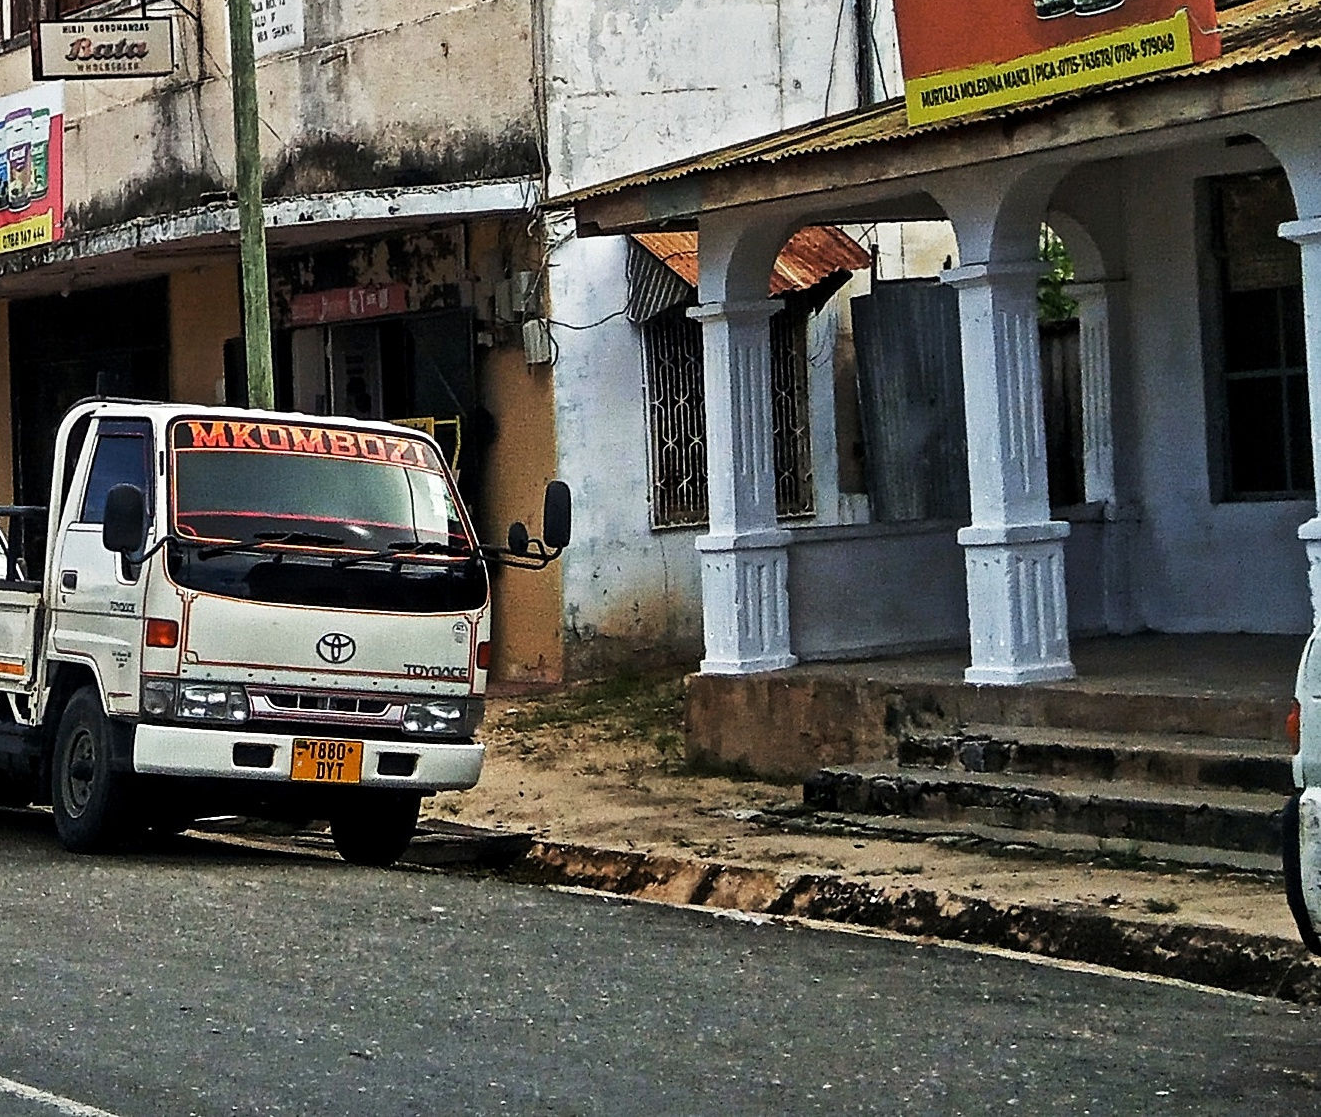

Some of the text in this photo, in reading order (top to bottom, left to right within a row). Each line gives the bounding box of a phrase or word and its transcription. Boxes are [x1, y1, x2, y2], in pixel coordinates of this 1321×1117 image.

[65, 37, 150, 61] Bata
[188, 421, 428, 468] MKOMBOZI
[404, 664, 468, 678] TOYOACE
[309, 741, 347, 760] T880
[315, 762, 345, 780] DYT
